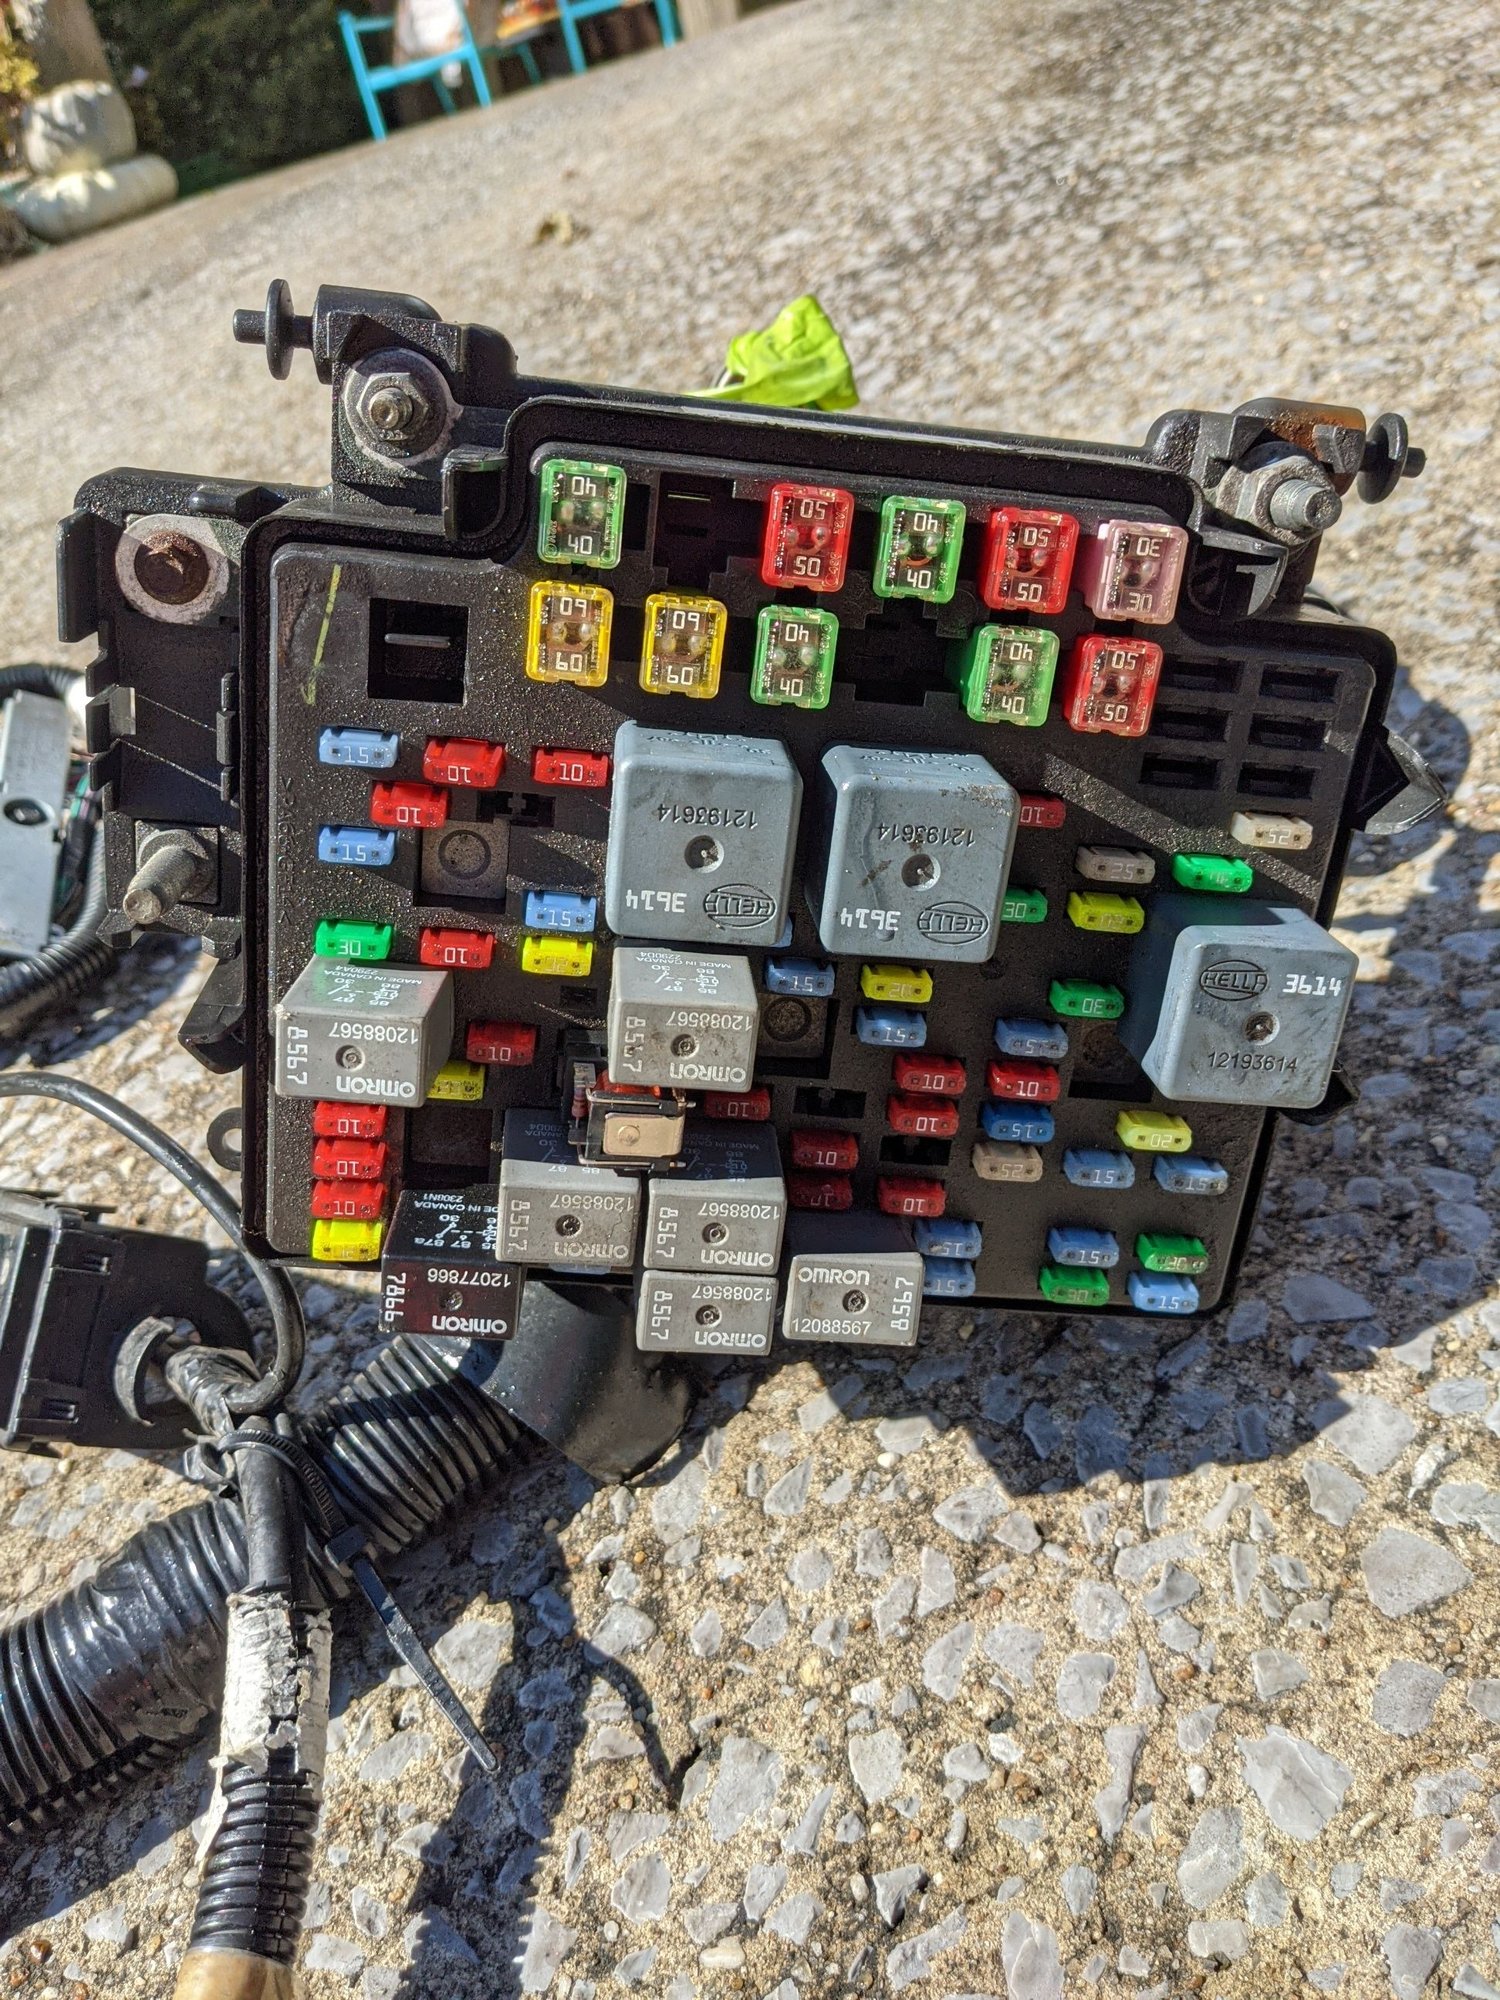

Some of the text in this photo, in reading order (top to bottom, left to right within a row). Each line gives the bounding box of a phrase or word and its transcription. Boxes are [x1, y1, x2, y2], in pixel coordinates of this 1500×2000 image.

[571, 476, 597, 498] 40
[800, 500, 826, 519] 50
[913, 513, 938, 533] 40
[568, 533, 593, 555] 40
[1023, 527, 1050, 548] 50
[1136, 537, 1162, 557] 30
[792, 557, 821, 577] 50
[906, 569, 932, 589] 40
[1014, 583, 1043, 603] 50
[1125, 592, 1152, 613] 30
[559, 597, 587, 617] 60
[672, 610, 700, 630] 60
[785, 623, 810, 642] 40
[1010, 642, 1034, 661] 40
[1112, 651, 1139, 671] 50
[555, 652, 582, 672] 60
[666, 666, 694, 686] 60
[779, 678, 803, 697] 40
[1001, 696, 1025, 716] 40
[1101, 704, 1129, 724] 50
[345, 745, 369, 764] 15
[447, 765, 472, 783] 10
[558, 763, 584, 782] 10
[396, 806, 422, 824] 10
[657, 802, 759, 831] 12193614
[1020, 806, 1044, 824] 10
[877, 821, 976, 848] 12193614
[1268, 829, 1291, 845] 25
[341, 843, 367, 862] 15
[1110, 862, 1135, 881] 25
[625, 889, 688, 914] 3614
[705, 894, 774, 917] HELLA
[1002, 902, 1027, 918] 30
[547, 909, 571, 927] 15
[840, 907, 901, 931] 3614
[918, 911, 989, 934] HELLA
[337, 938, 361, 956] 30
[444, 947, 469, 965] 10
[636, 957, 683, 965] CANADA
[699, 961, 732, 969] MADE
[324, 969, 373, 980] CANADA
[388, 976, 423, 985] MADE
[790, 975, 814, 992] 15
[1203, 970, 1267, 994] HELLA
[1282, 974, 1343, 998] 3614
[1082, 998, 1105, 1015] 30
[665, 1010, 753, 1031] 12088567
[328, 1021, 418, 1044] 12088567
[883, 1027, 906, 1043] 15
[287, 1026, 308, 1086] 8567
[488, 1046, 511, 1062] 10
[1206, 1051, 1298, 1073] 12193614
[335, 1075, 416, 1098] OMRON
[922, 1074, 945, 1090] 10
[1016, 1081, 1039, 1097] 10
[727, 1102, 750, 1117] 10
[338, 1119, 360, 1134] 10
[916, 1116, 939, 1132] 10
[1012, 1123, 1033, 1139] 15
[1150, 1133, 1173, 1148] 20
[337, 1160, 359, 1176] 10
[814, 1151, 837, 1166] 10
[548, 1165, 567, 1173] 87
[1000, 1163, 1023, 1178] 25
[1092, 1169, 1114, 1184] 15
[1185, 1178, 1206, 1191] 15
[334, 1200, 355, 1215] 10
[414, 1201, 466, 1211] CANADA
[549, 1193, 634, 1212] 12088567
[698, 1201, 780, 1220] 12088567
[903, 1198, 926, 1213] 10
[438, 1214, 460, 1222] 30
[508, 1199, 531, 1252] 8567
[413, 1237, 445, 1247] 87a
[658, 1207, 679, 1259] 8567
[450, 1240, 472, 1248] 87
[554, 1242, 629, 1260] OMRON
[942, 1242, 964, 1256] 15
[701, 1249, 774, 1267] OMRON
[1078, 1250, 1100, 1264] 15
[1168, 1256, 1187, 1270] 30
[427, 1267, 511, 1288] 12077866
[798, 1267, 870, 1286] OMRON
[691, 1284, 772, 1302] 12088567
[935, 1280, 956, 1293] 15
[384, 1273, 407, 1323] 7866
[890, 1277, 915, 1331] 8567
[1158, 1295, 1179, 1310] 15
[431, 1315, 508, 1334] OMRON
[651, 1290, 673, 1341] 8567
[792, 1318, 872, 1336] 12088567
[694, 1330, 767, 1348] OMRON
